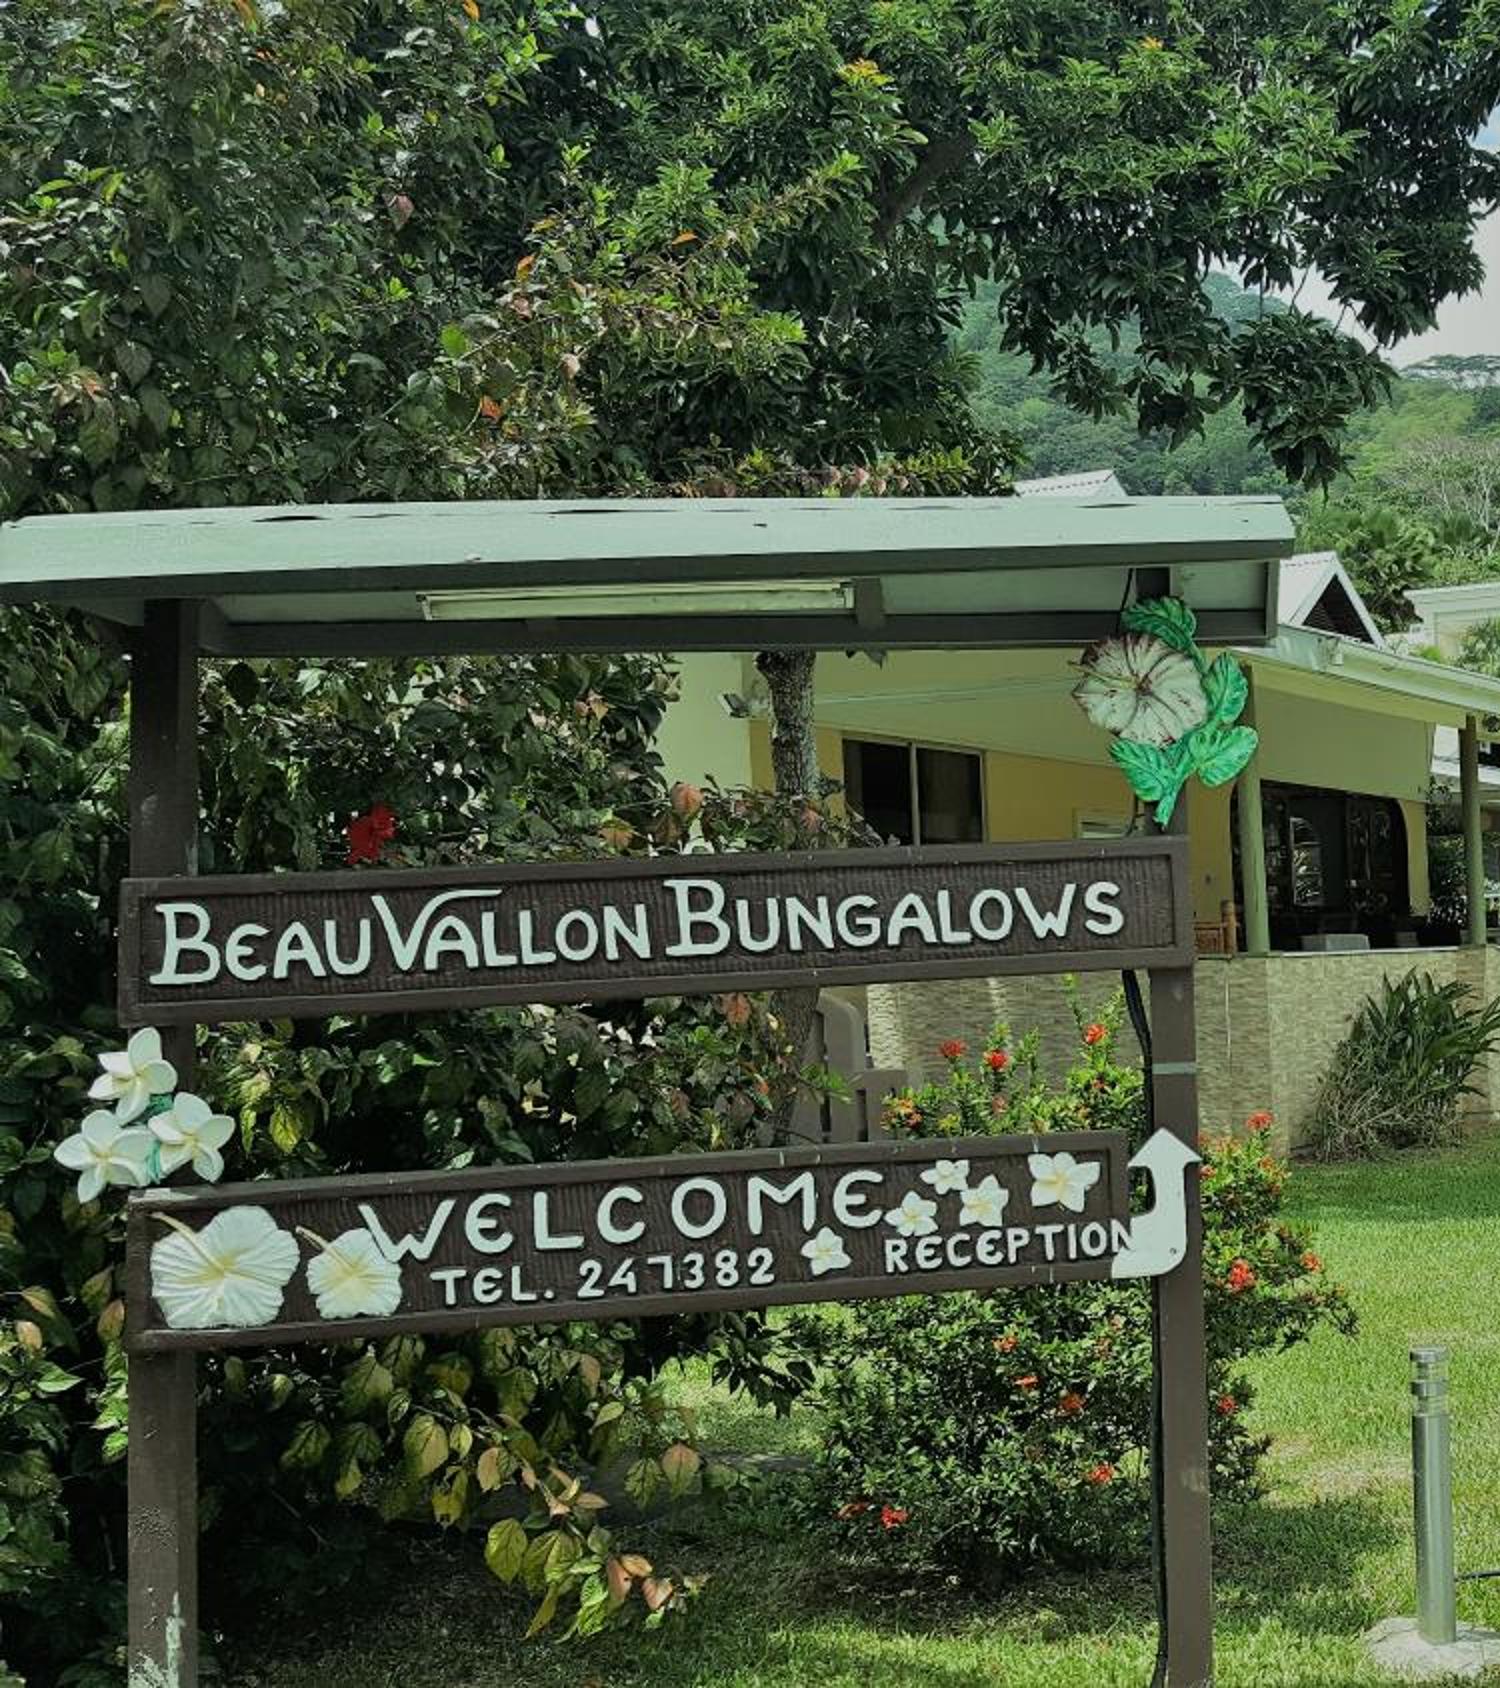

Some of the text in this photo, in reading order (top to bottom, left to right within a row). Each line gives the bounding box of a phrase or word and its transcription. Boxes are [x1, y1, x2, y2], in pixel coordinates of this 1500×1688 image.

[663, 878, 1125, 958] BUNGALOWS
[358, 1169, 885, 1264] WELCOME
[884, 1218, 1133, 1274] RECEPTION
[431, 1247, 776, 1306] TEL. 247382
